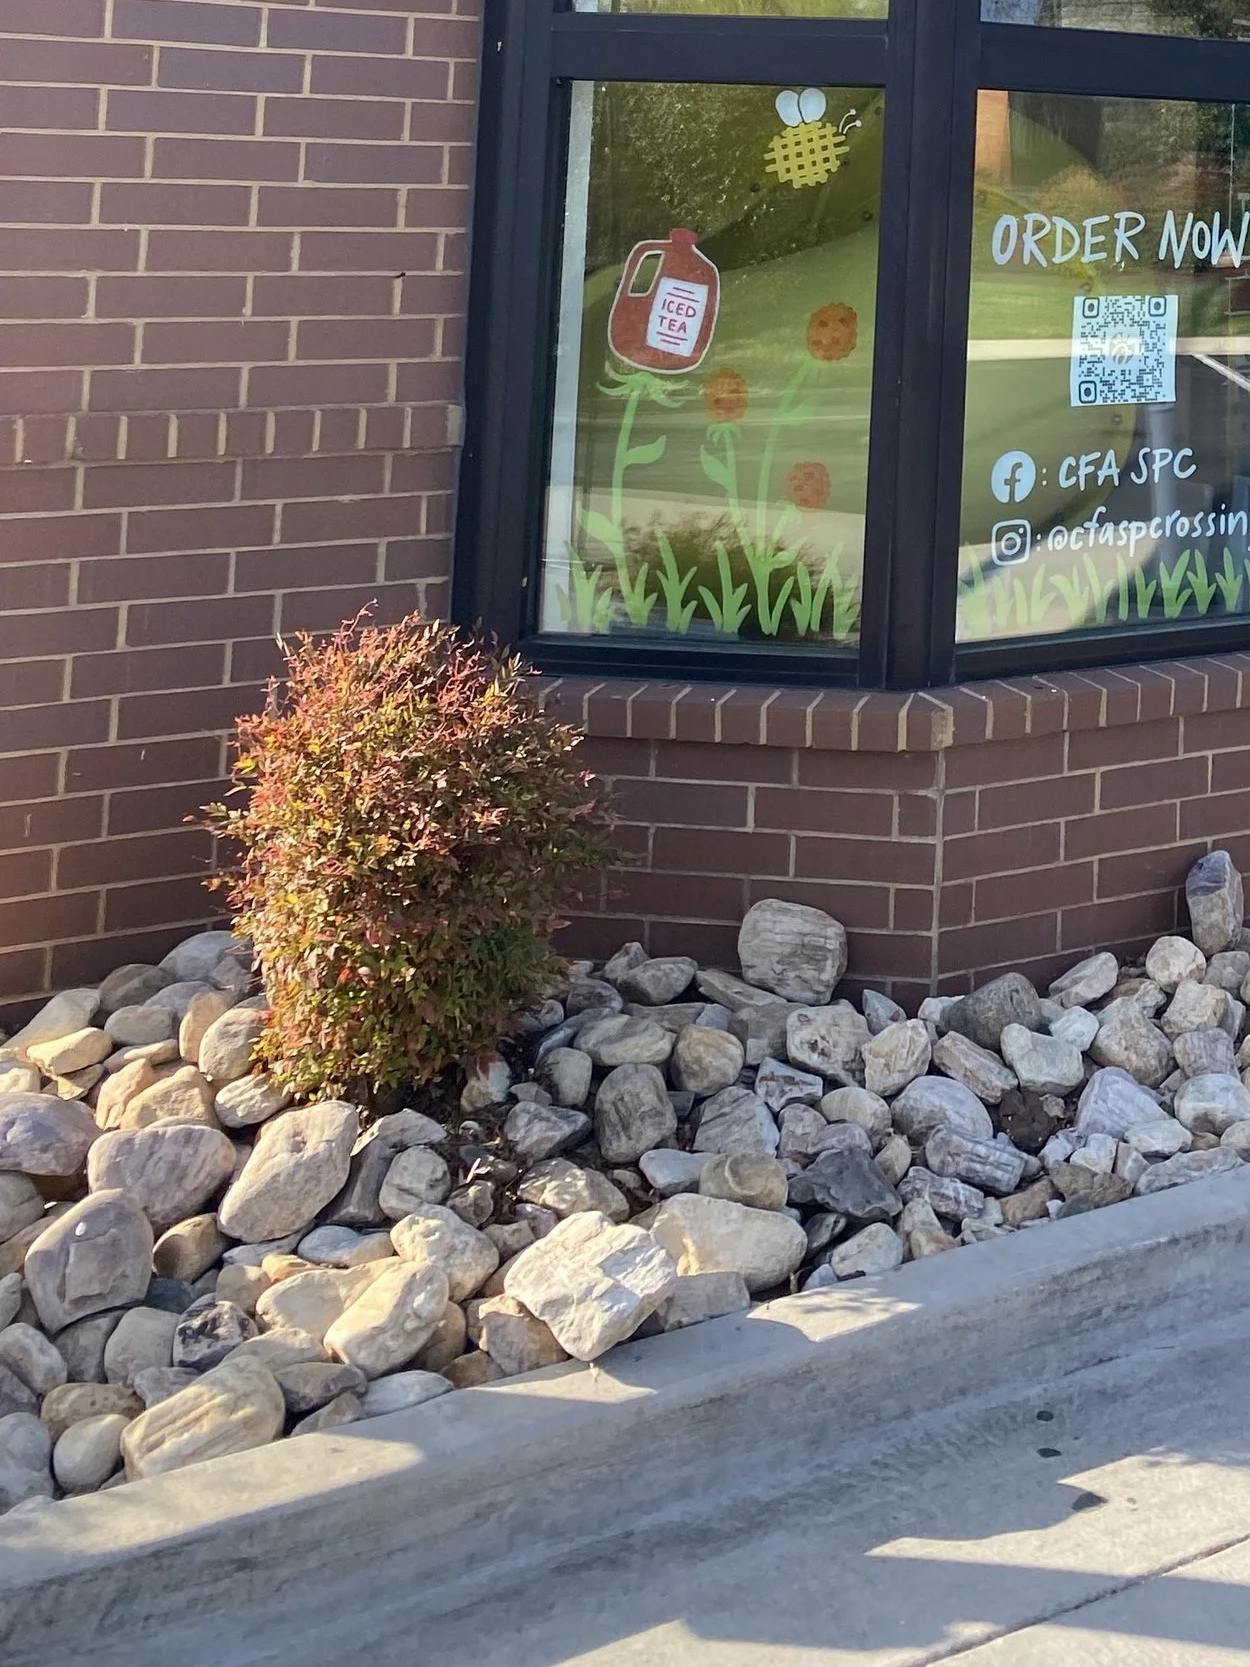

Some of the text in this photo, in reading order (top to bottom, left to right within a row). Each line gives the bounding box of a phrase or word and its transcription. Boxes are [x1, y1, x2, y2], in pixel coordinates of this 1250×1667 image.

[991, 211, 1146, 268] ORDER
[661, 298, 697, 318] ICED
[658, 315, 687, 334] TEA
[1129, 446, 1197, 485] SPC
